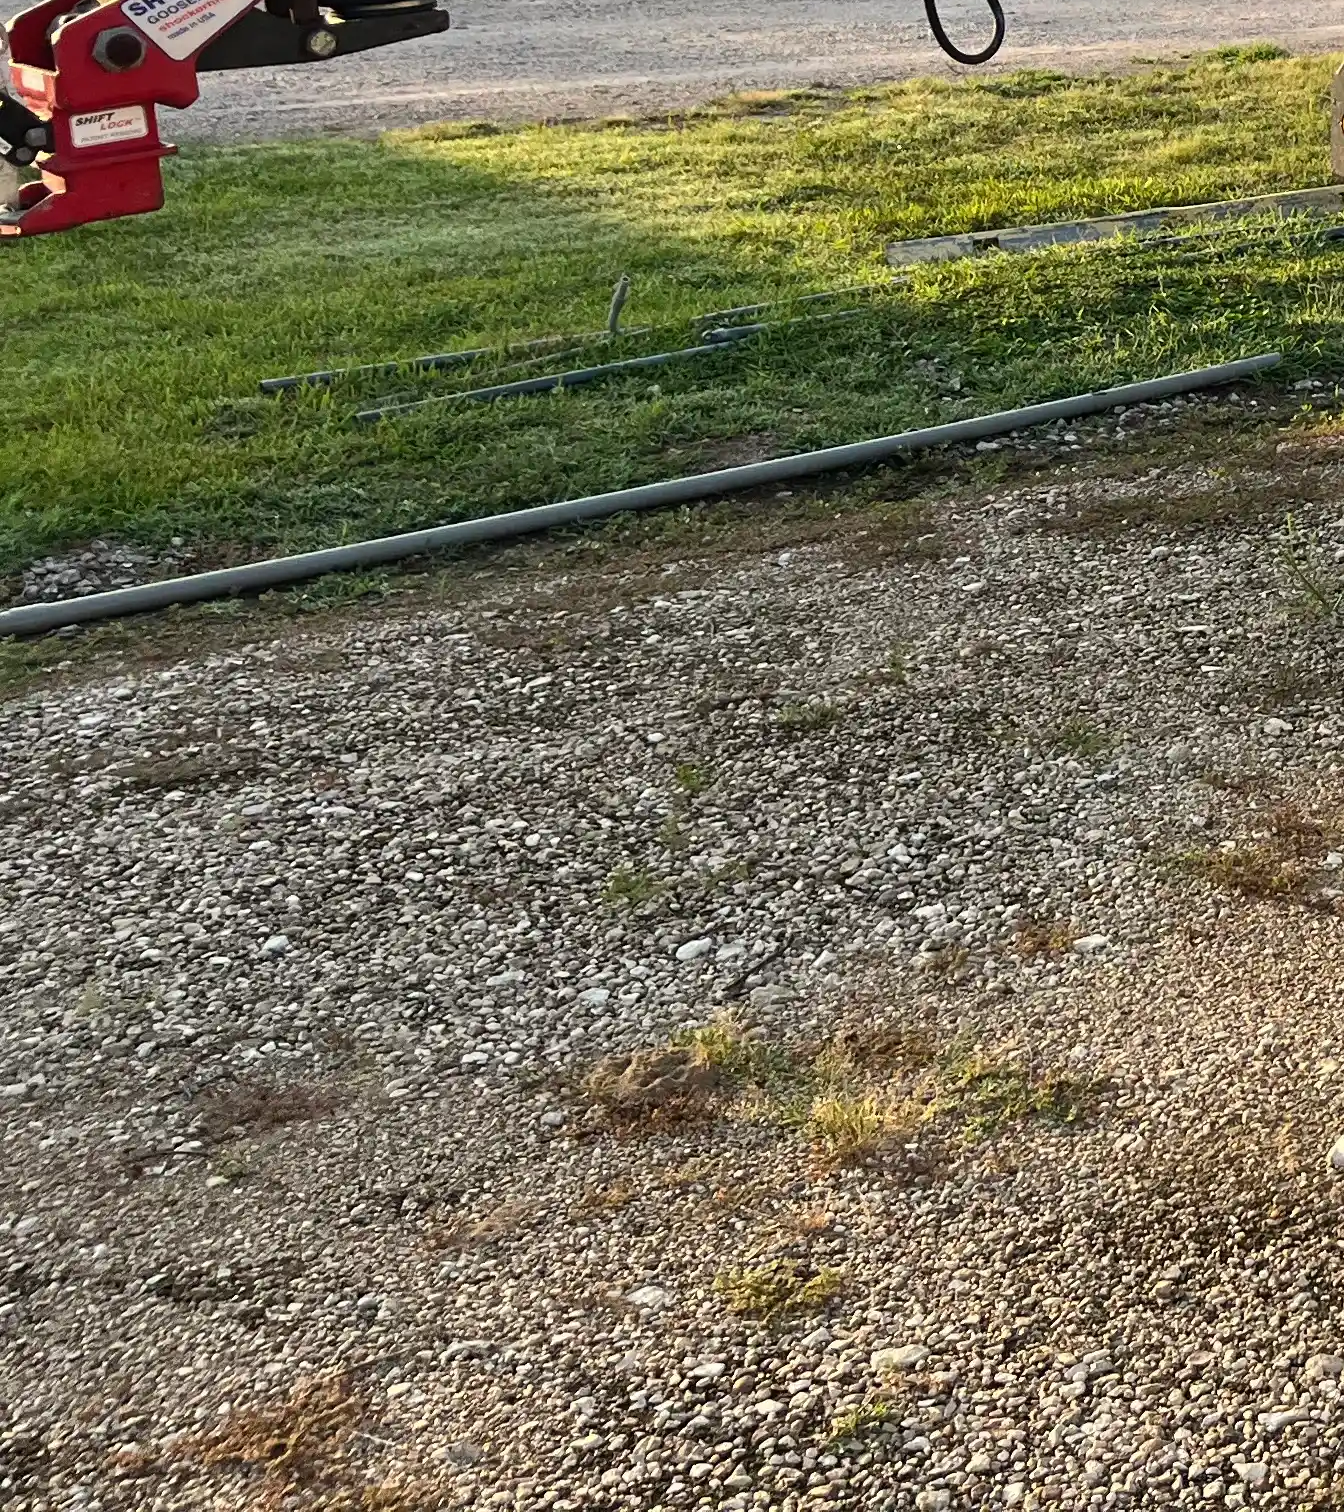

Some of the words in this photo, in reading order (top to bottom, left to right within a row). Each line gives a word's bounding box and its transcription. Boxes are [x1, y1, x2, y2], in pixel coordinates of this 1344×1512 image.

[196, 11, 216, 24] USA
[75, 112, 115, 127] SHIFT
[100, 118, 134, 131] LOCK
